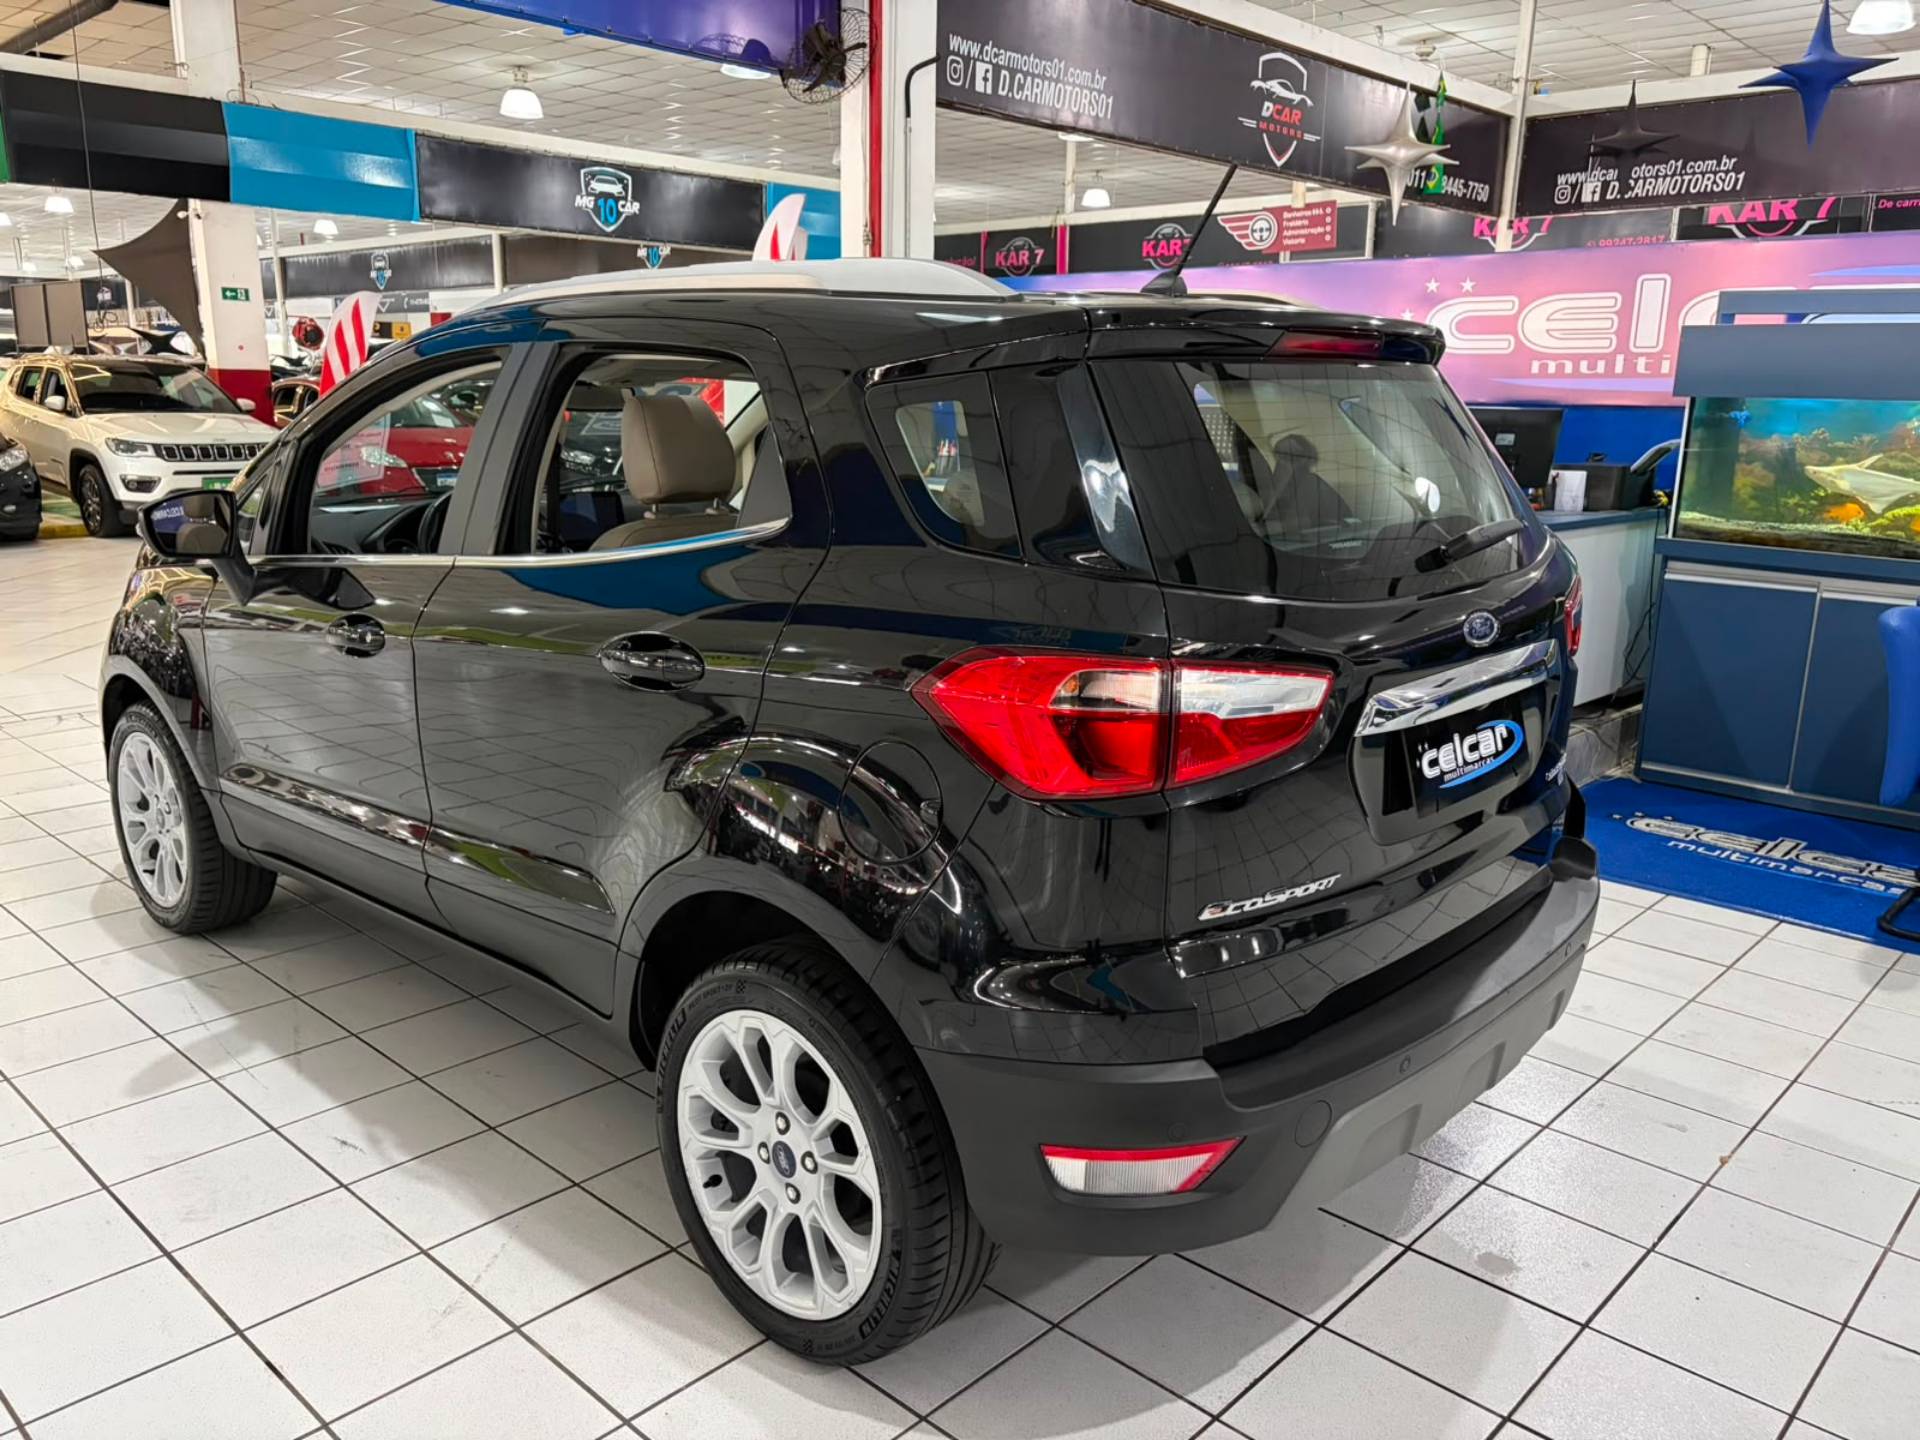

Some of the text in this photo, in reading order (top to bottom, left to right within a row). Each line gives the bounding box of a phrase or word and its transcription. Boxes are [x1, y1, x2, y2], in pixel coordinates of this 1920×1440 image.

[949, 33, 1107, 91] www.dcarmotors01.com.br
[998, 69, 1114, 120] D.CARMOTORS01
[1261, 100, 1303, 126] DCAR
[1557, 154, 1738, 186] www.dcarotors01.com.br
[598, 197, 618, 225] 10
[618, 199, 641, 215] CAR
[995, 249, 1030, 267] KAR
[1034, 247, 1045, 265] 7
[1142, 238, 1183, 258] KAR
[1530, 353, 1671, 375] multi
[1421, 723, 1508, 779] celcar
